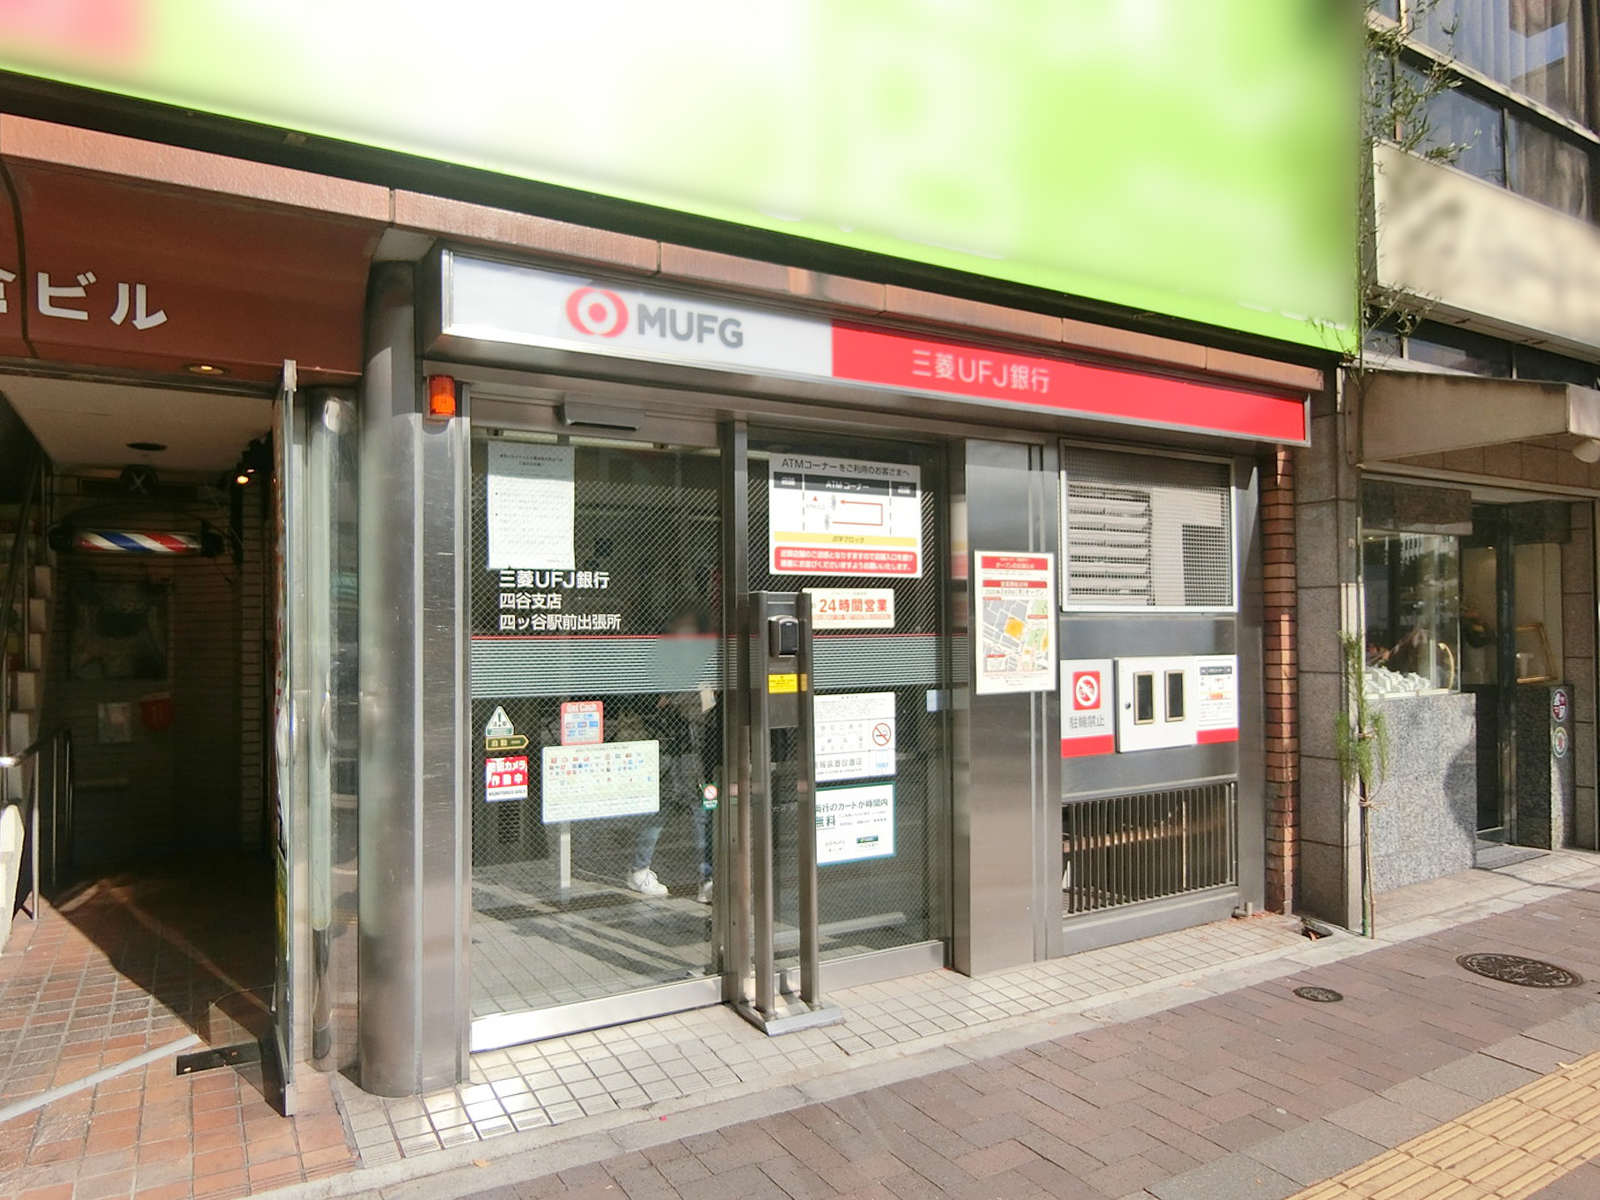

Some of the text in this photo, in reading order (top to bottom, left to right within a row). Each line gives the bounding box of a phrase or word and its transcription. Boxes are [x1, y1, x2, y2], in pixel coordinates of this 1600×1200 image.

[637, 303, 743, 348] MUFG
[910, 347, 1051, 394] 三菱UFJ銀行
[499, 569, 611, 590] 三菱UFJ銀行
[499, 593, 563, 610] 四谷支店
[819, 598, 887, 613] 24時間営業
[499, 613, 622, 631] 四ッ谷駅前出張所
